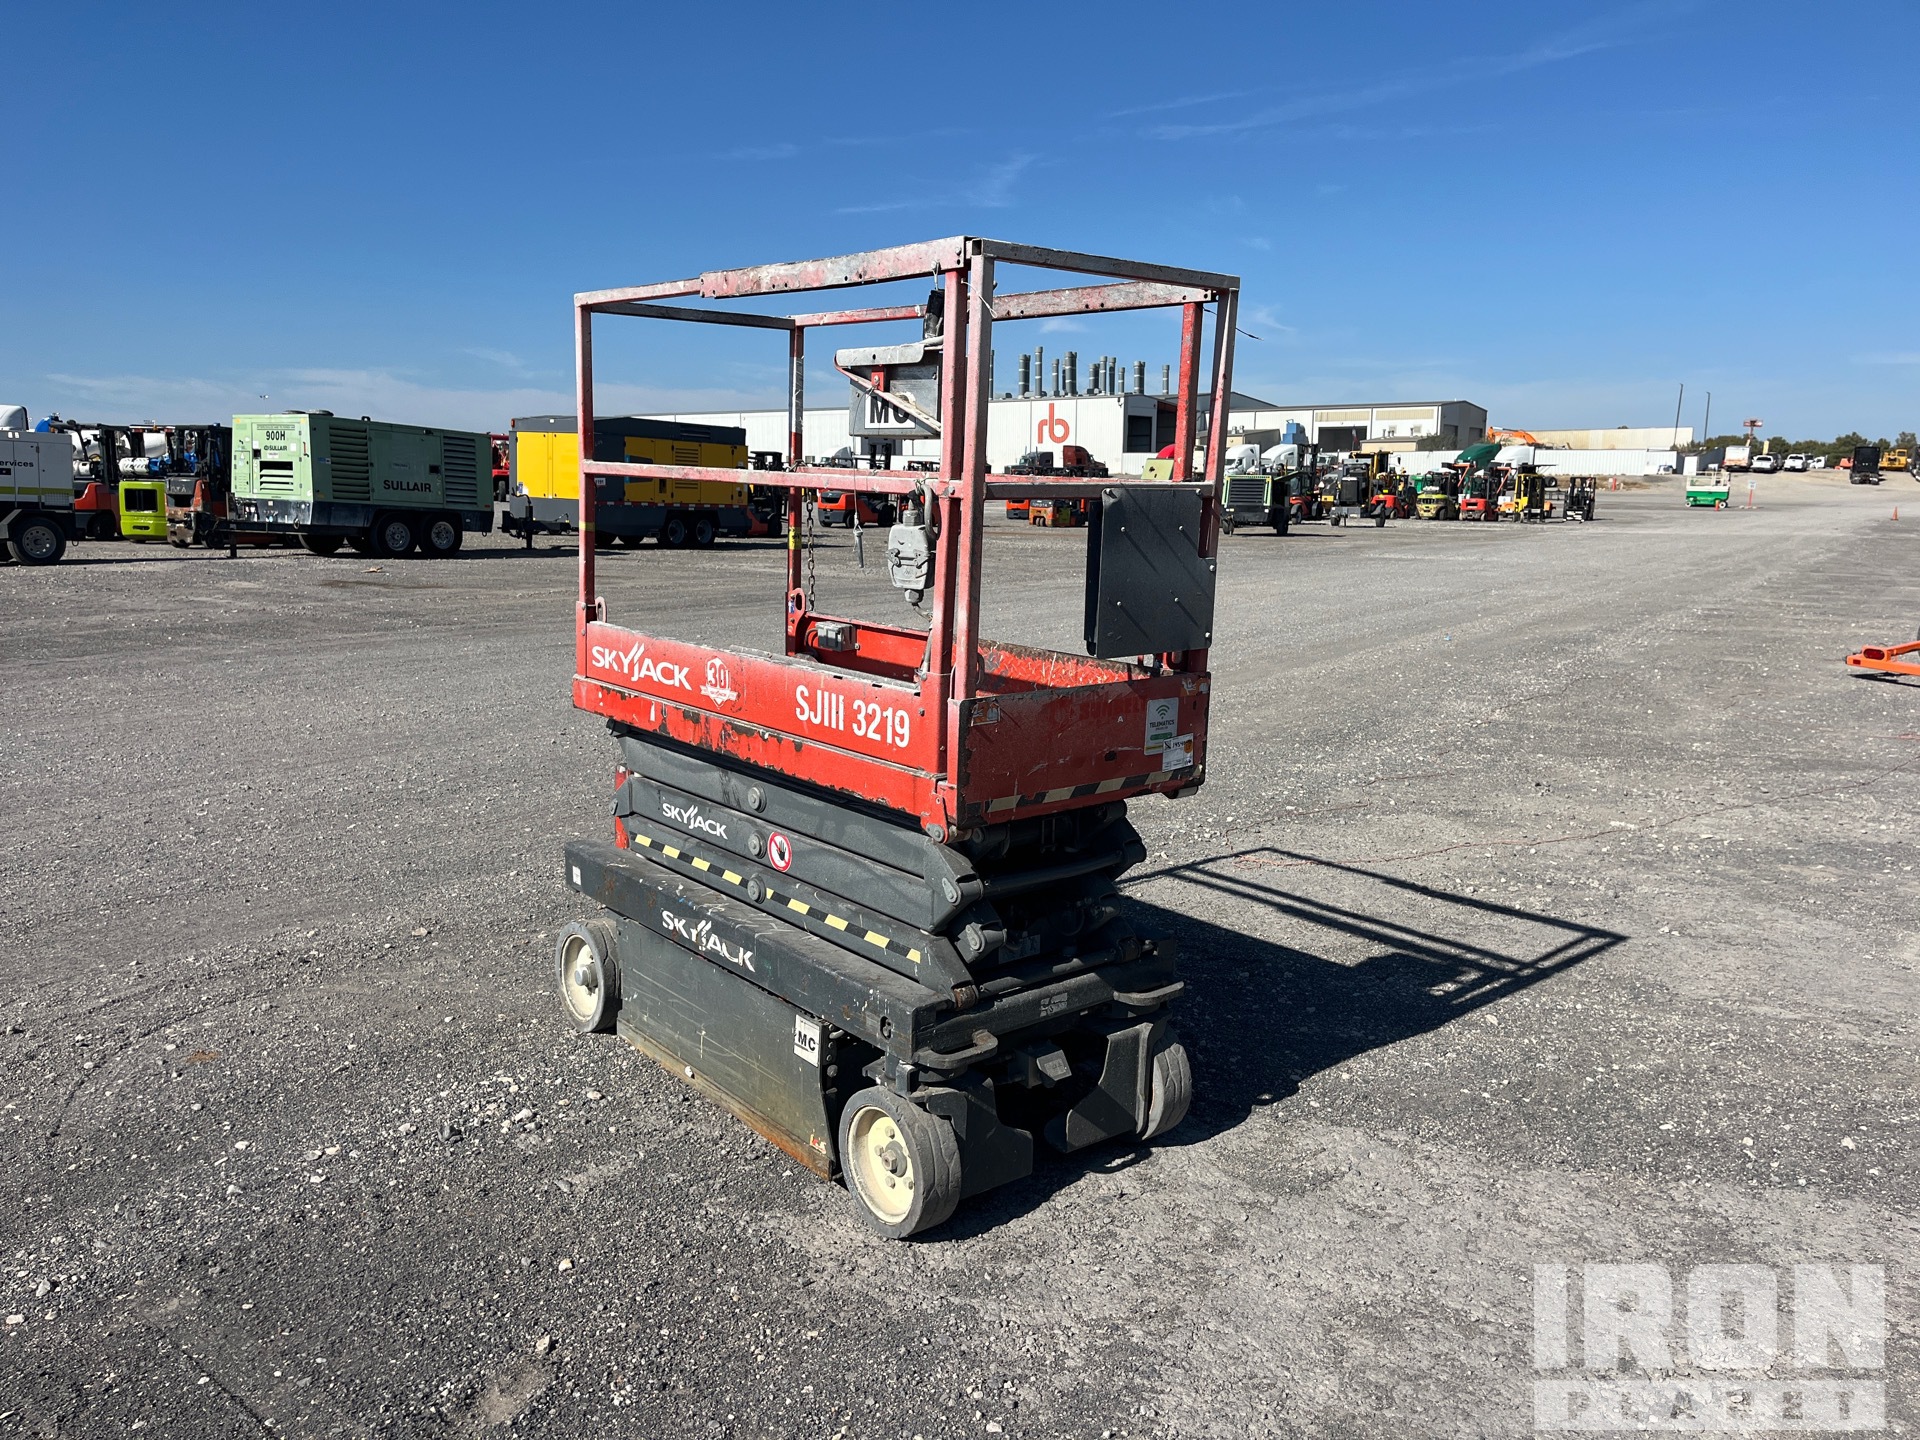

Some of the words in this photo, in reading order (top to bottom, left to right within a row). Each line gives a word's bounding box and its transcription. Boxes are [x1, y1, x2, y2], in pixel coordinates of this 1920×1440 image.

[265, 430, 286, 441] 900H
[1037, 402, 1070, 444] rb
[383, 479, 432, 493] SULLAIR
[591, 641, 693, 691] SKYJACK
[709, 662, 727, 689] 30
[795, 684, 845, 731] SJIII
[852, 699, 911, 748] 3219
[1150, 719, 1175, 728] TELEMATICS
[662, 803, 729, 840] SKYJACK
[662, 910, 756, 973] SKYJACK
[797, 1030, 816, 1051] MC
